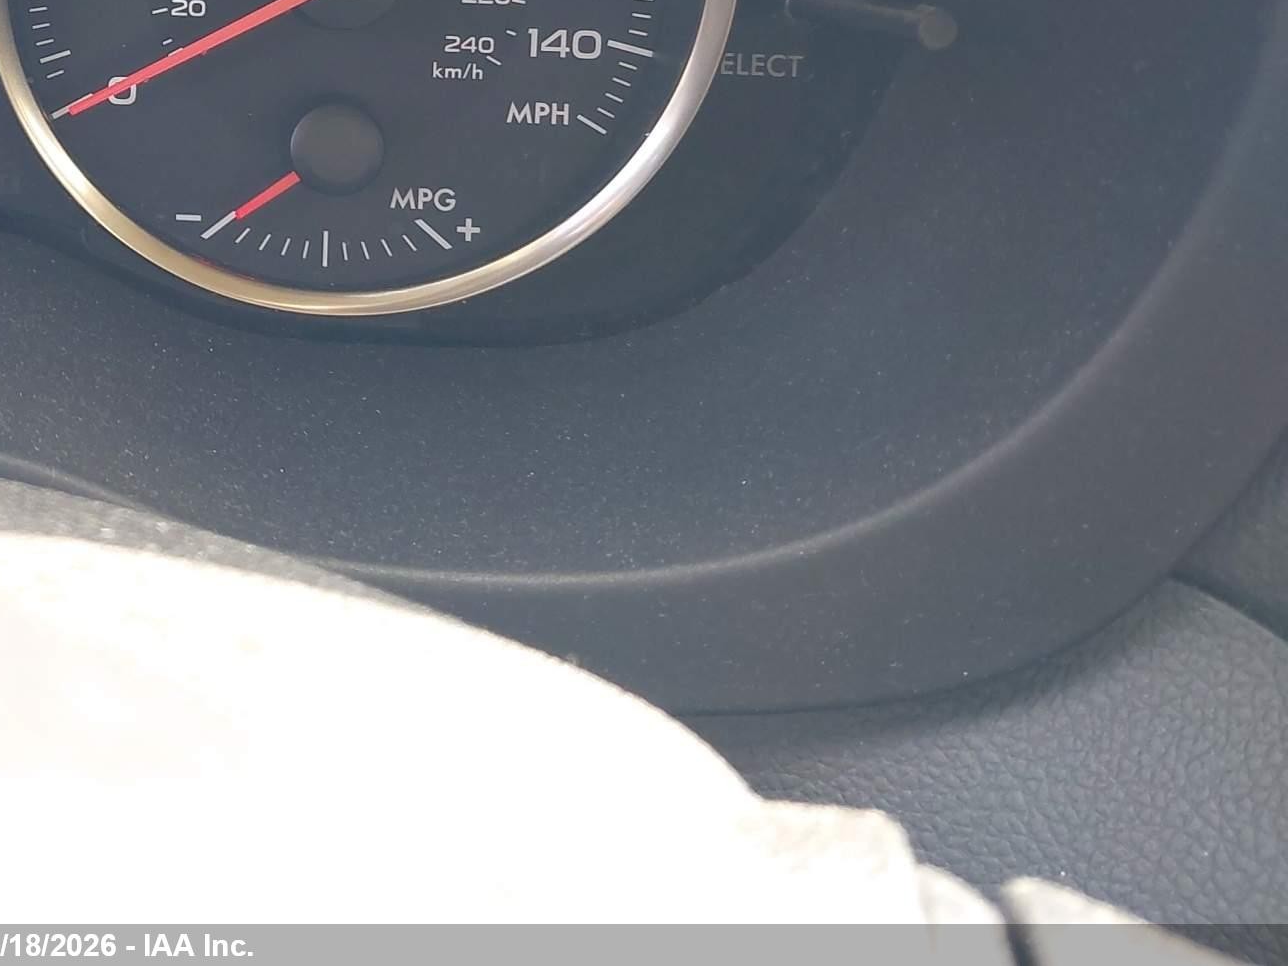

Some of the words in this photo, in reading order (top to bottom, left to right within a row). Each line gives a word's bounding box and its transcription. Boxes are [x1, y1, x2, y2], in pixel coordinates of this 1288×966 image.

[444, 36, 495, 55] 240
[528, 29, 602, 60] 140
[432, 61, 484, 80] km/h
[507, 103, 570, 126] MPH
[390, 188, 457, 212] MPG
